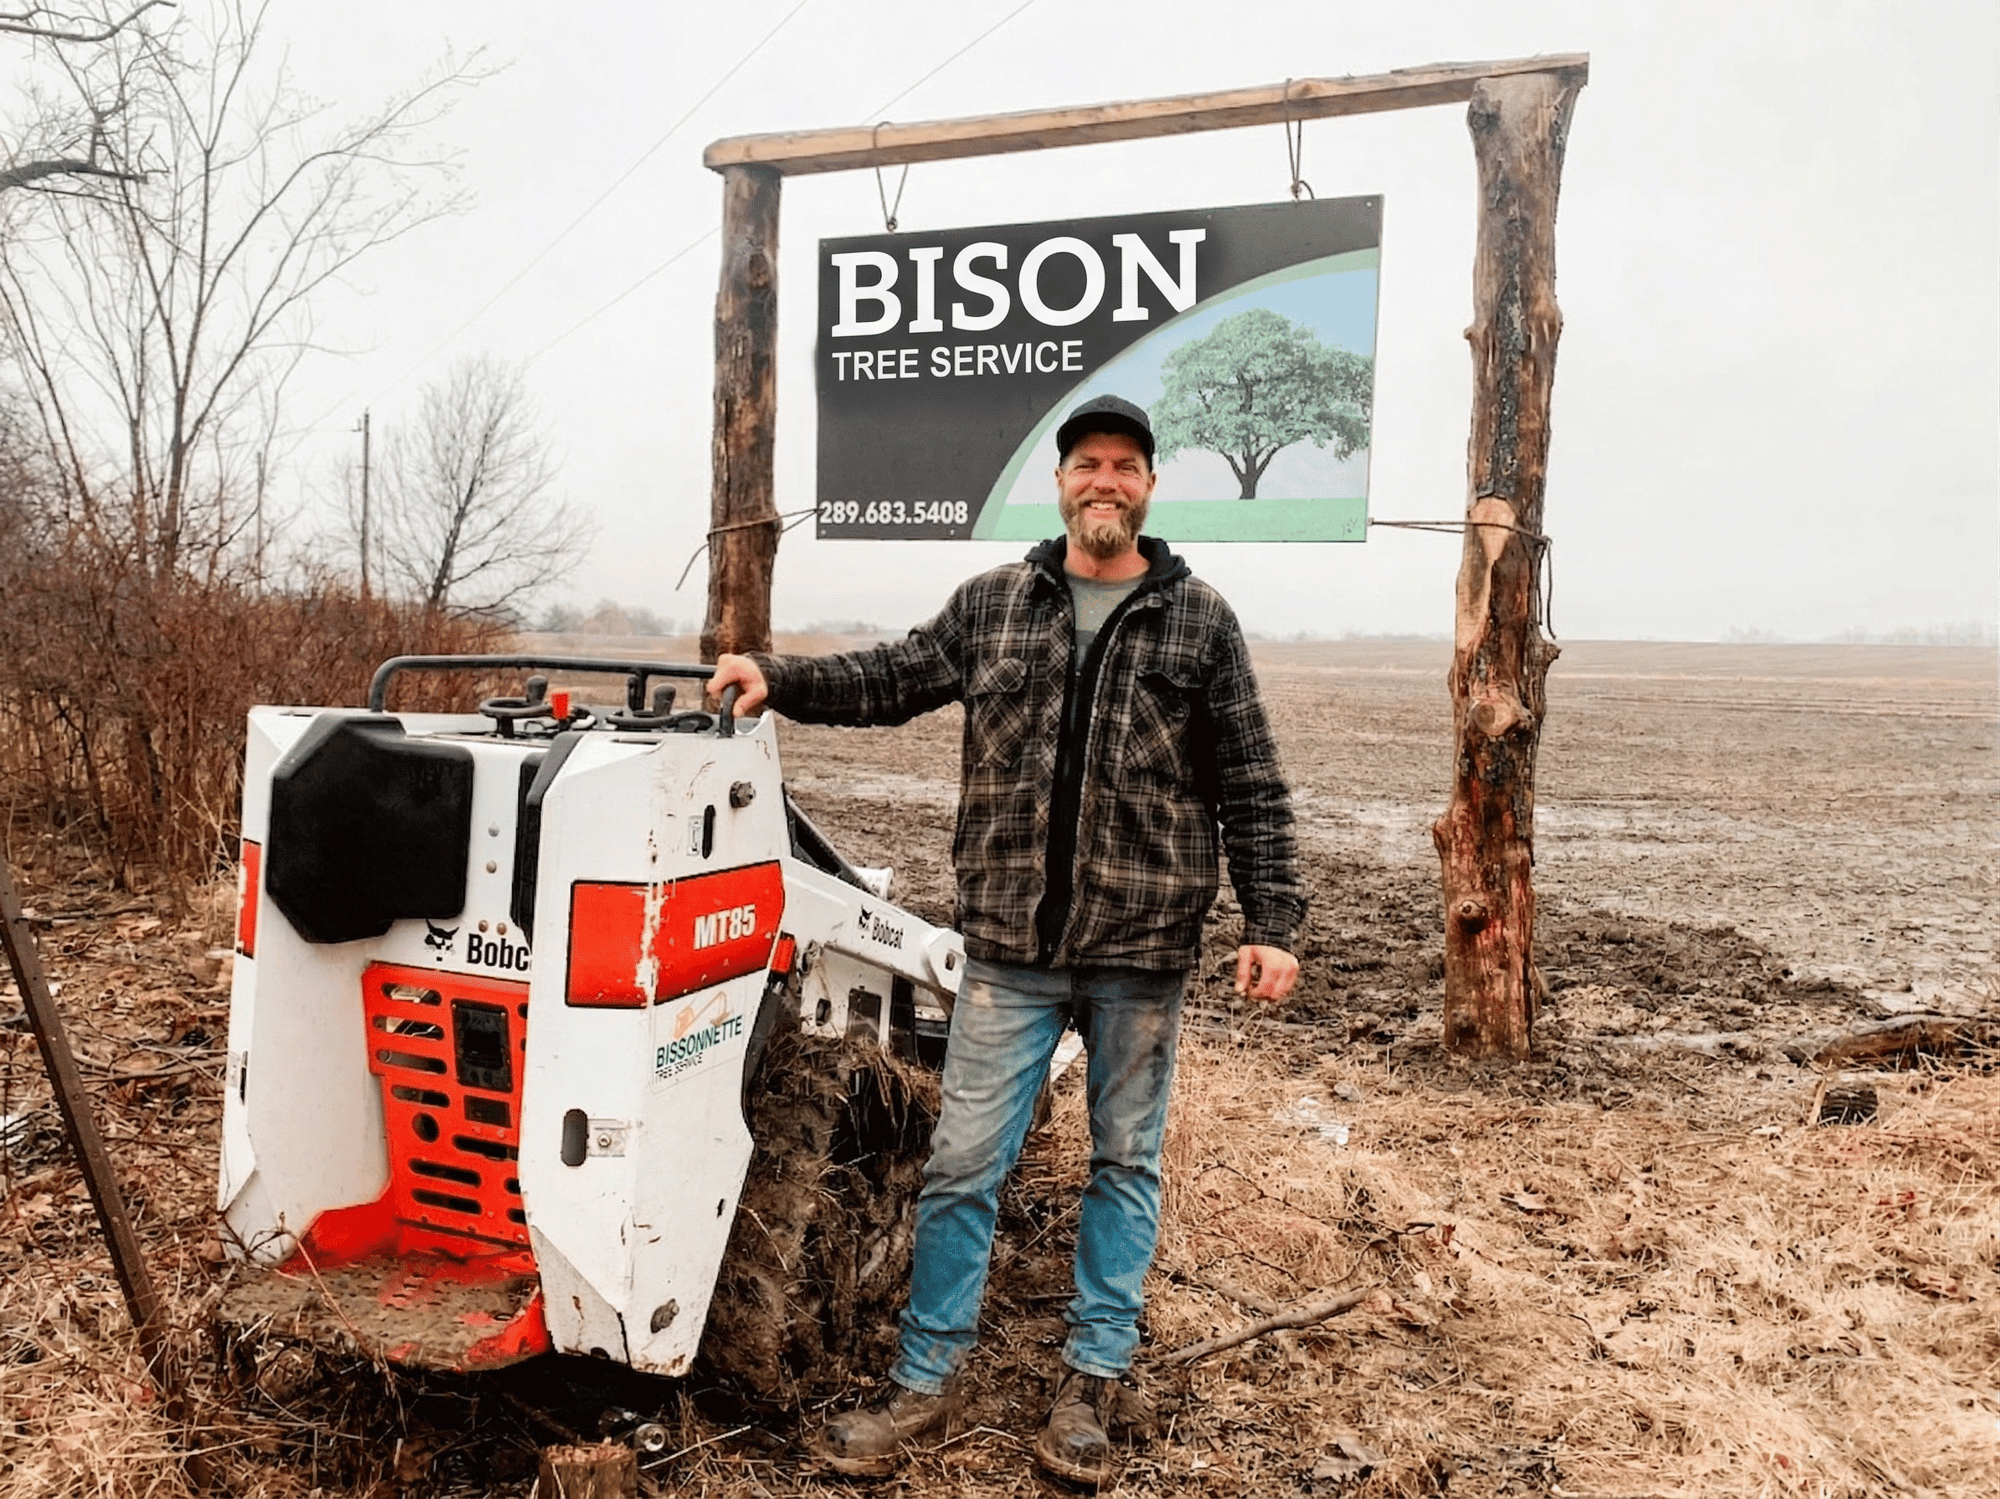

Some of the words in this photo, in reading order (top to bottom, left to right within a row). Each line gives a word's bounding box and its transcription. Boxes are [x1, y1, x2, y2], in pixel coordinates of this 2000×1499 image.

[831, 228, 1206, 337] BISON
[832, 348, 919, 381] TREE
[930, 340, 1083, 377] SERVICE
[819, 500, 968, 524] 289.683.5408
[694, 903, 756, 950] MT85
[872, 916, 904, 949] Bobcat
[467, 933, 532, 971] Bobc
[656, 1014, 742, 1068] BISSONNETTE
